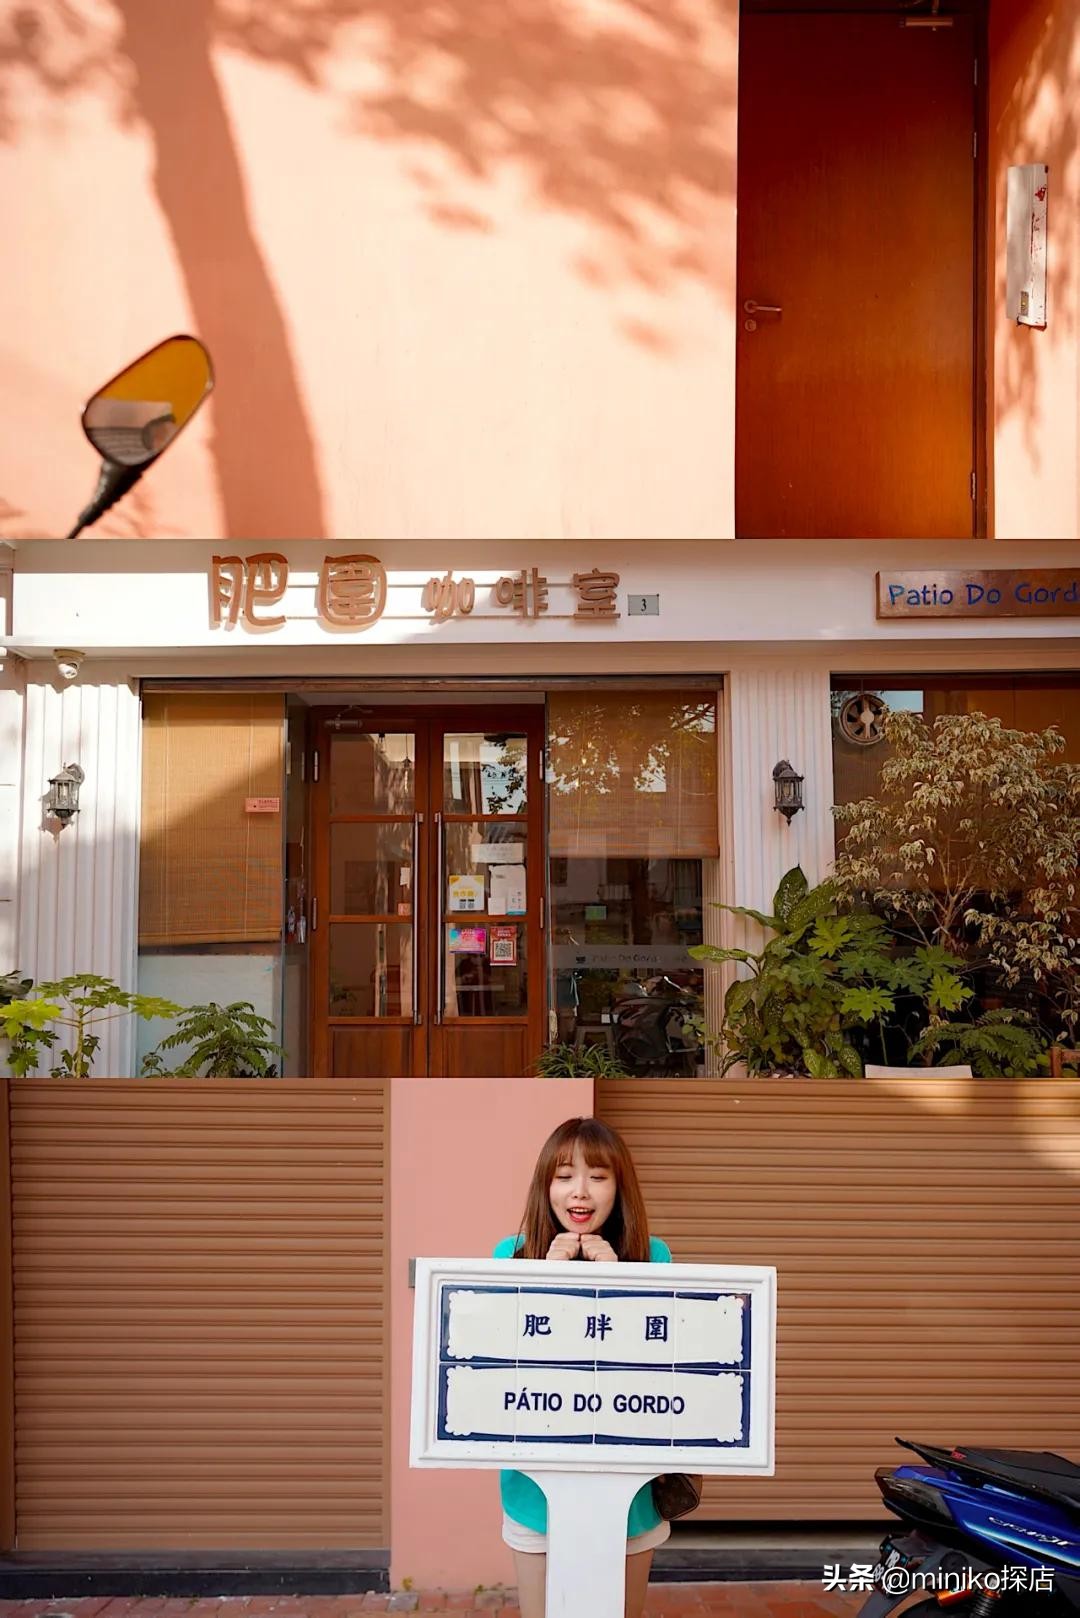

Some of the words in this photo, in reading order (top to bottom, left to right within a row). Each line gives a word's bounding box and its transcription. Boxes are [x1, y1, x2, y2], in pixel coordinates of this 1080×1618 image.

[640, 598, 648, 612] 3
[888, 583, 954, 607] Patio
[965, 584, 1001, 606] Do
[522, 1313, 669, 1342] 肥胖圍
[504, 1387, 563, 1411] PÁTIO
[573, 1393, 603, 1413] DO
[613, 1394, 685, 1415] GORDO
